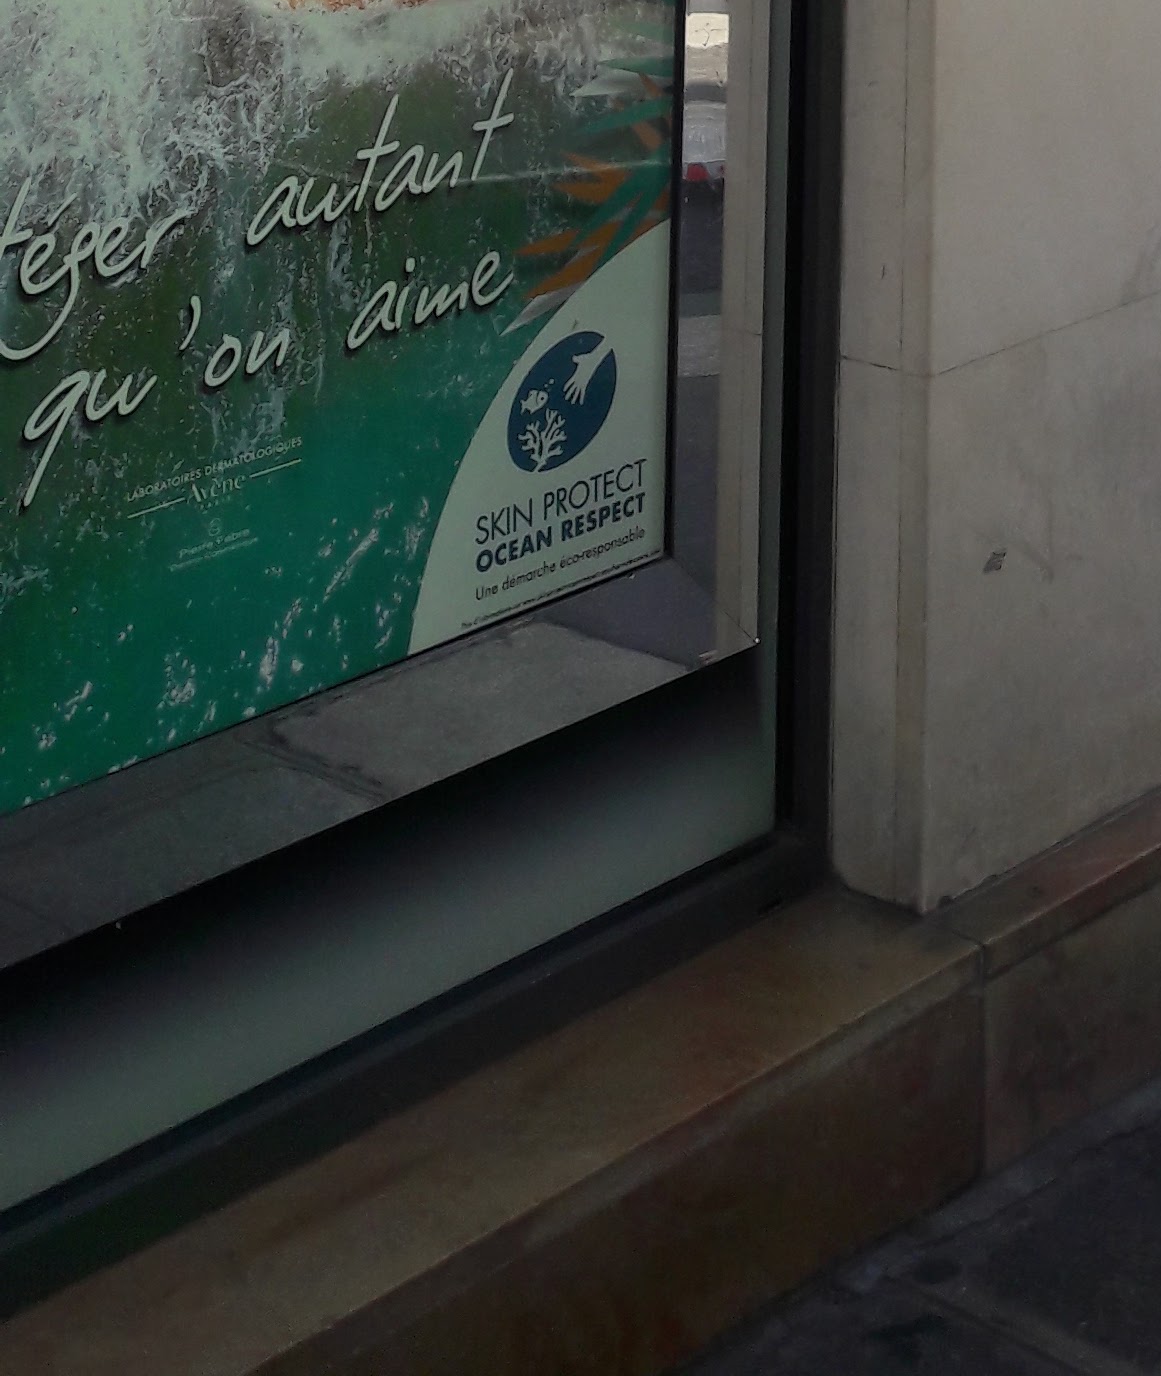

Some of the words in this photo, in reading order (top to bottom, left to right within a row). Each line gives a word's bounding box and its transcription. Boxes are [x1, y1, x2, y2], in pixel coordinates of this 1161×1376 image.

[247, 68, 515, 246] autant
[347, 249, 515, 350] aime
[127, 468, 201, 503] LABORATOIRES
[475, 498, 533, 545] SKIN
[543, 459, 647, 520] PROTECT
[476, 526, 552, 572] OCEAN
[561, 492, 645, 541] RESPECT
[475, 585, 499, 600] Une
[502, 560, 556, 591] démarche
